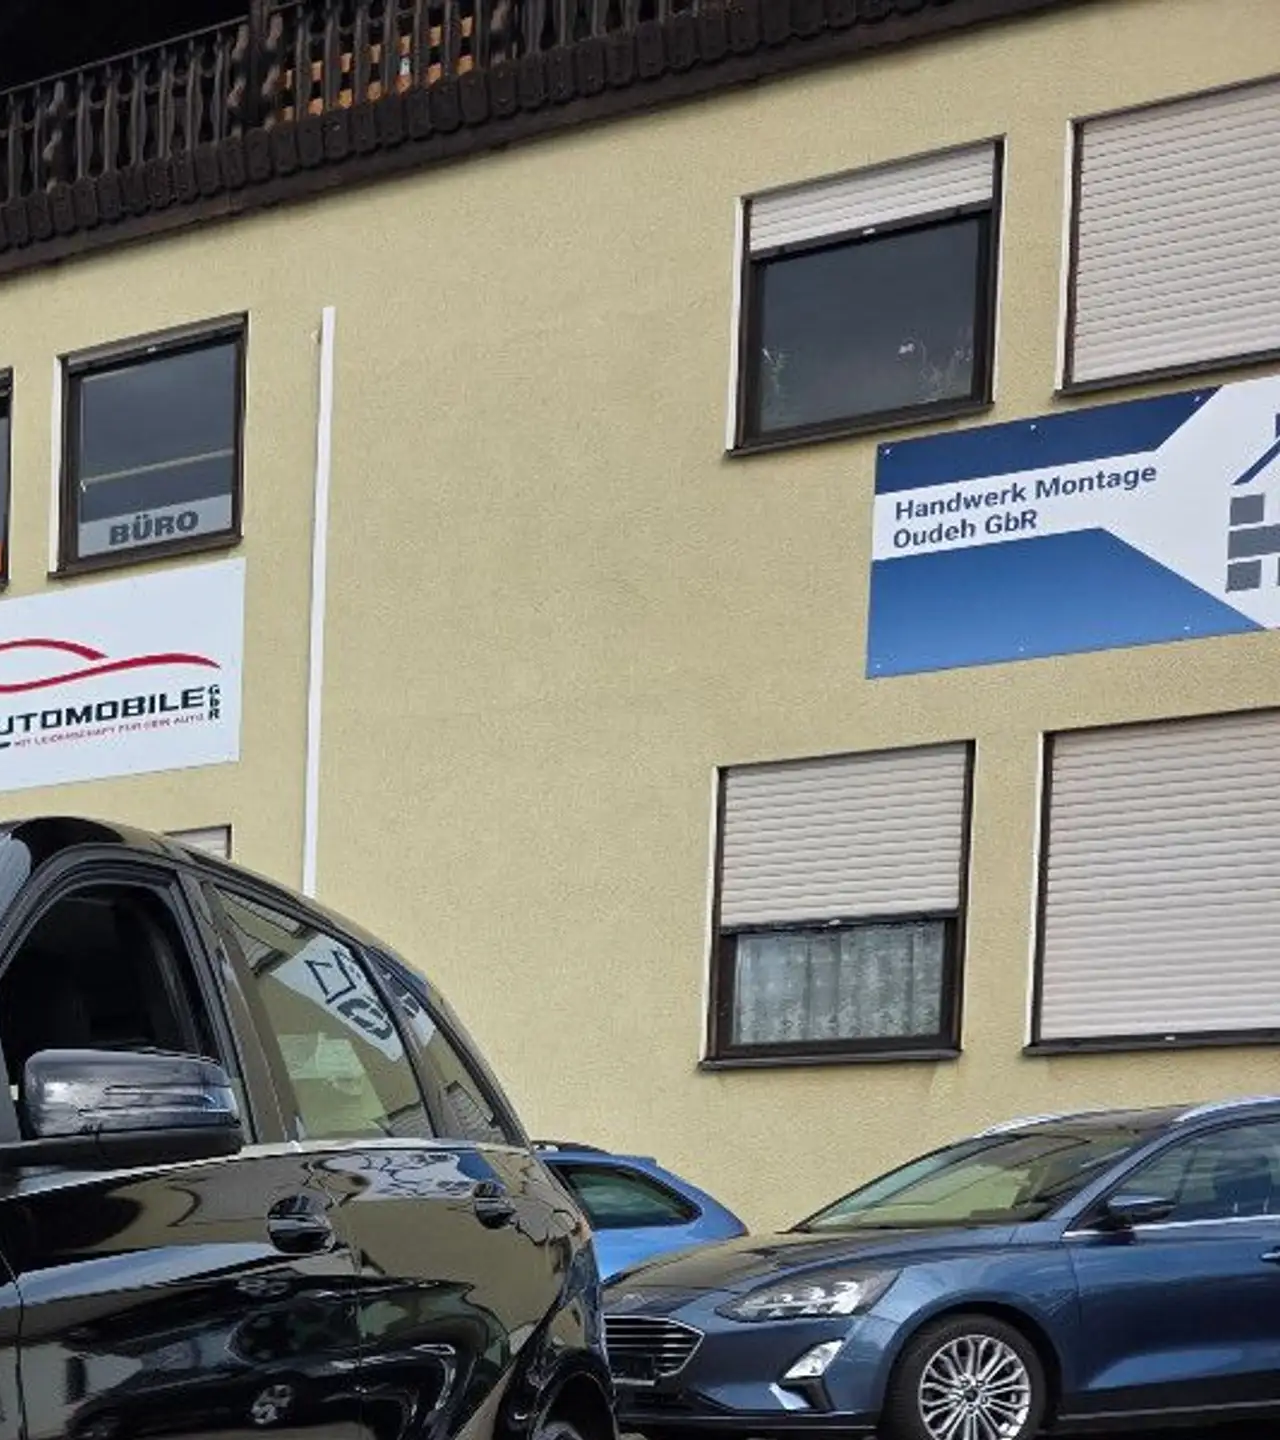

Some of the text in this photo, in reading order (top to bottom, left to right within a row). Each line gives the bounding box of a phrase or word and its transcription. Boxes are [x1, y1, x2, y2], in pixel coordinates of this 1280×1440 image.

[895, 466, 1158, 520] Handwerk Montage
[109, 511, 199, 546] BÜRO
[893, 509, 1038, 548] Oudeh GbR
